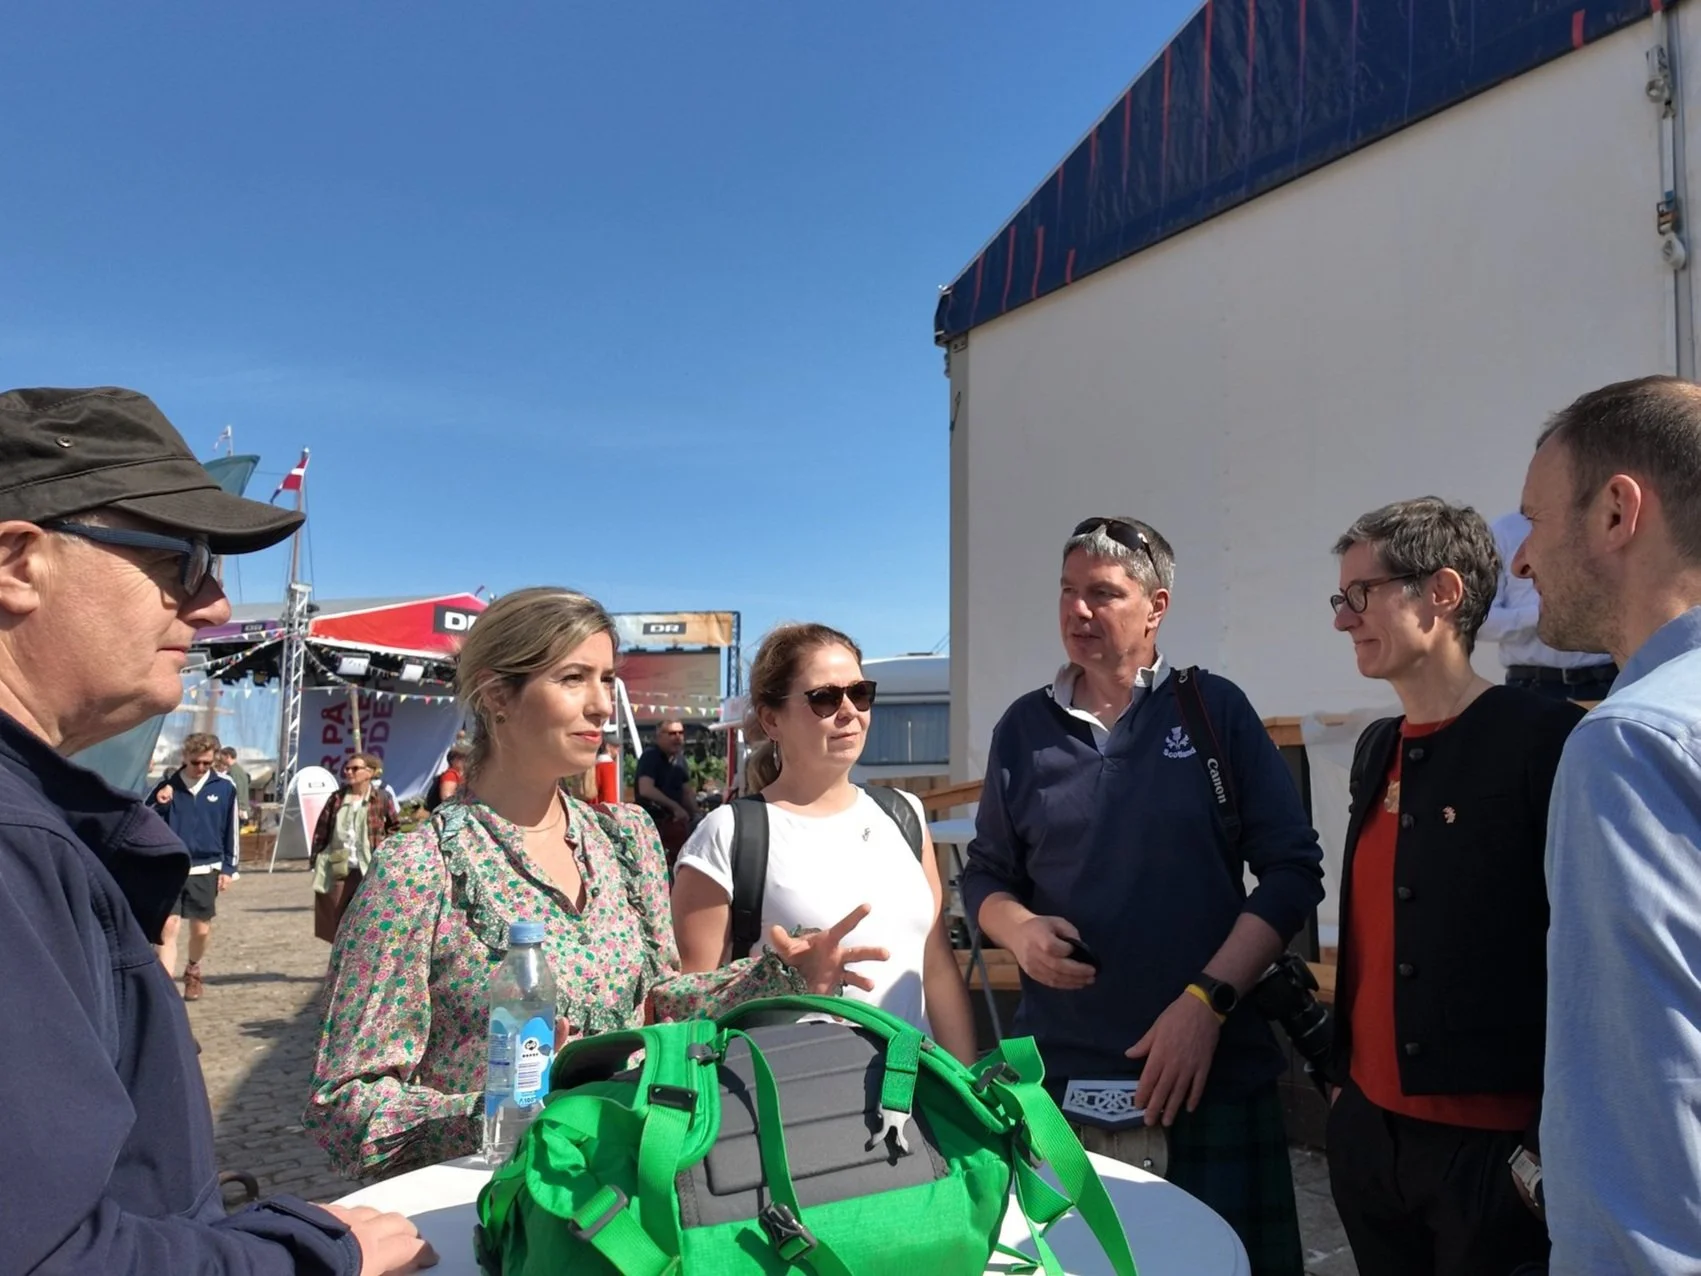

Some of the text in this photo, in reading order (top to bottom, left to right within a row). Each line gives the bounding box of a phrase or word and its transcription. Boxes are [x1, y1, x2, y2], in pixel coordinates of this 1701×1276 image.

[650, 624, 679, 632] DR
[321, 702, 347, 744] PÅ
[1163, 747, 1197, 758] Scotland
[1207, 757, 1227, 804] Canon
